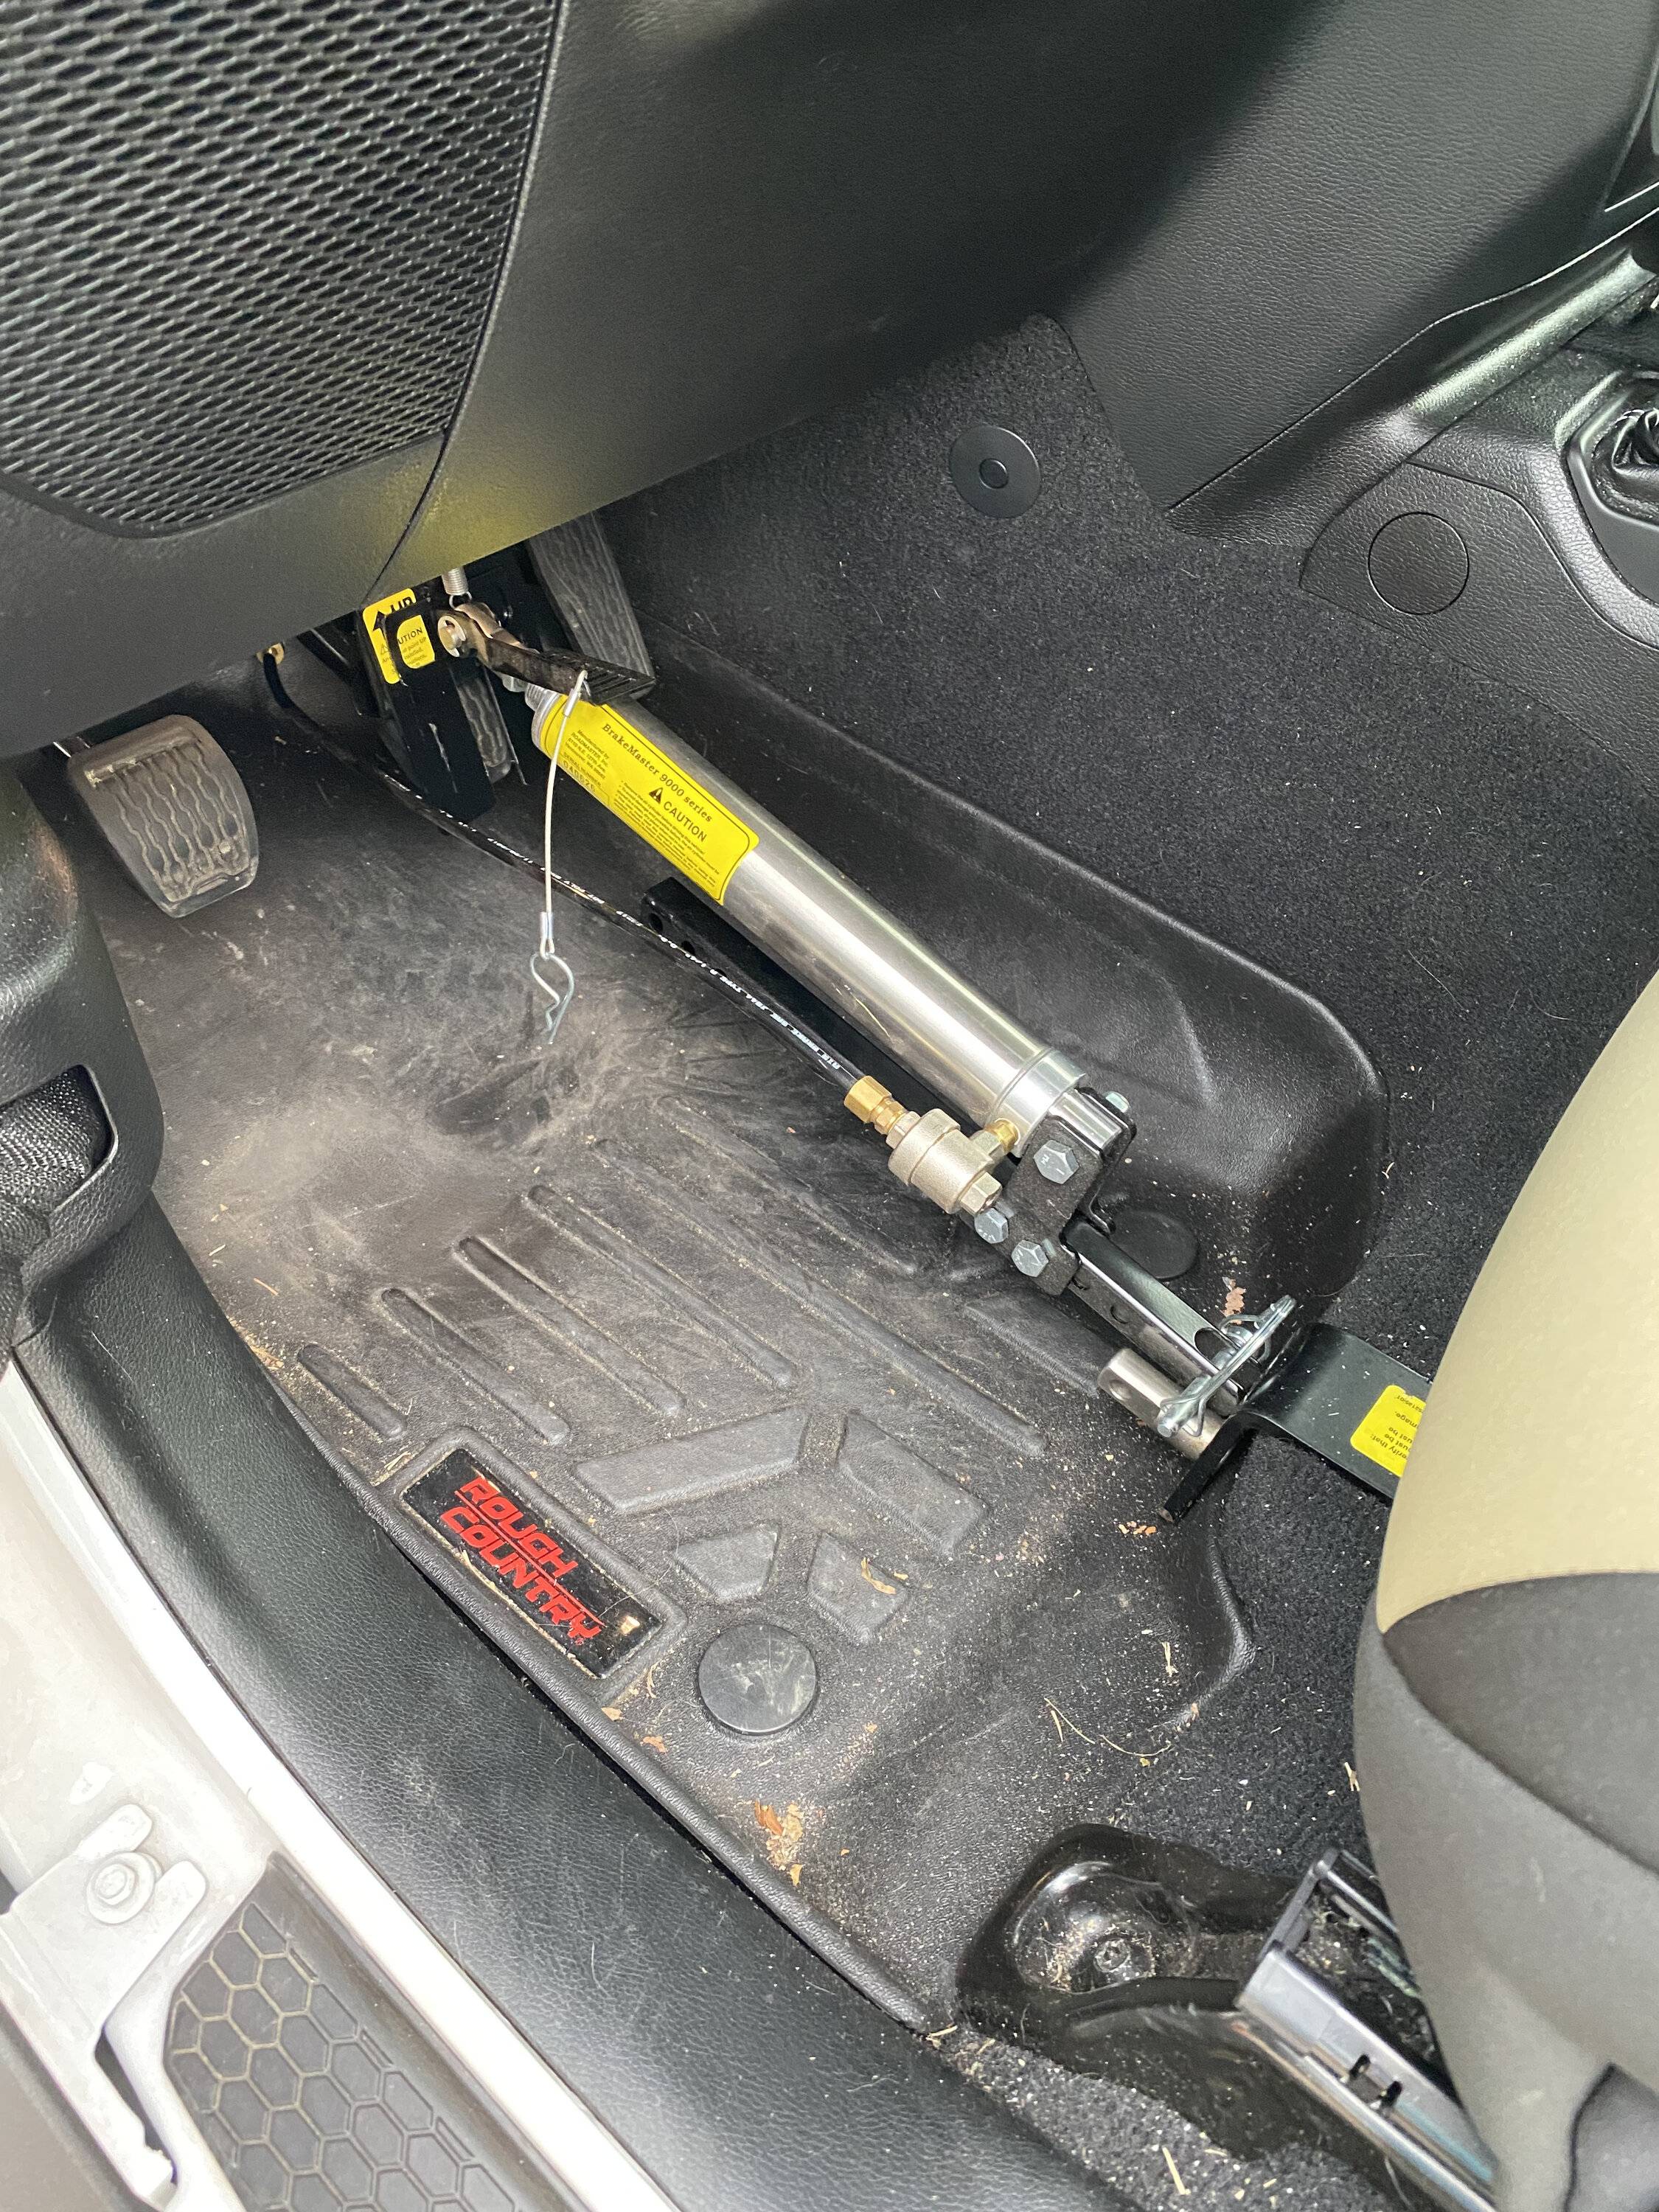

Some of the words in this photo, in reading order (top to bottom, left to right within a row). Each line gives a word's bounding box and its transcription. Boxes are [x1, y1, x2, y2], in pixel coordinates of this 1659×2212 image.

[398, 627, 423, 645] UTION
[602, 723, 660, 776] BrakeMaster
[659, 773, 685, 798] 9000
[684, 796, 713, 823] series
[663, 801, 707, 843] CAUTION
[1395, 1411, 1418, 1428] mage.
[1389, 1445, 1408, 1459] erify
[1399, 1433, 1413, 1444] ust
[459, 1476, 579, 1578] ROUGH
[440, 1506, 602, 1639] COUNTRY
